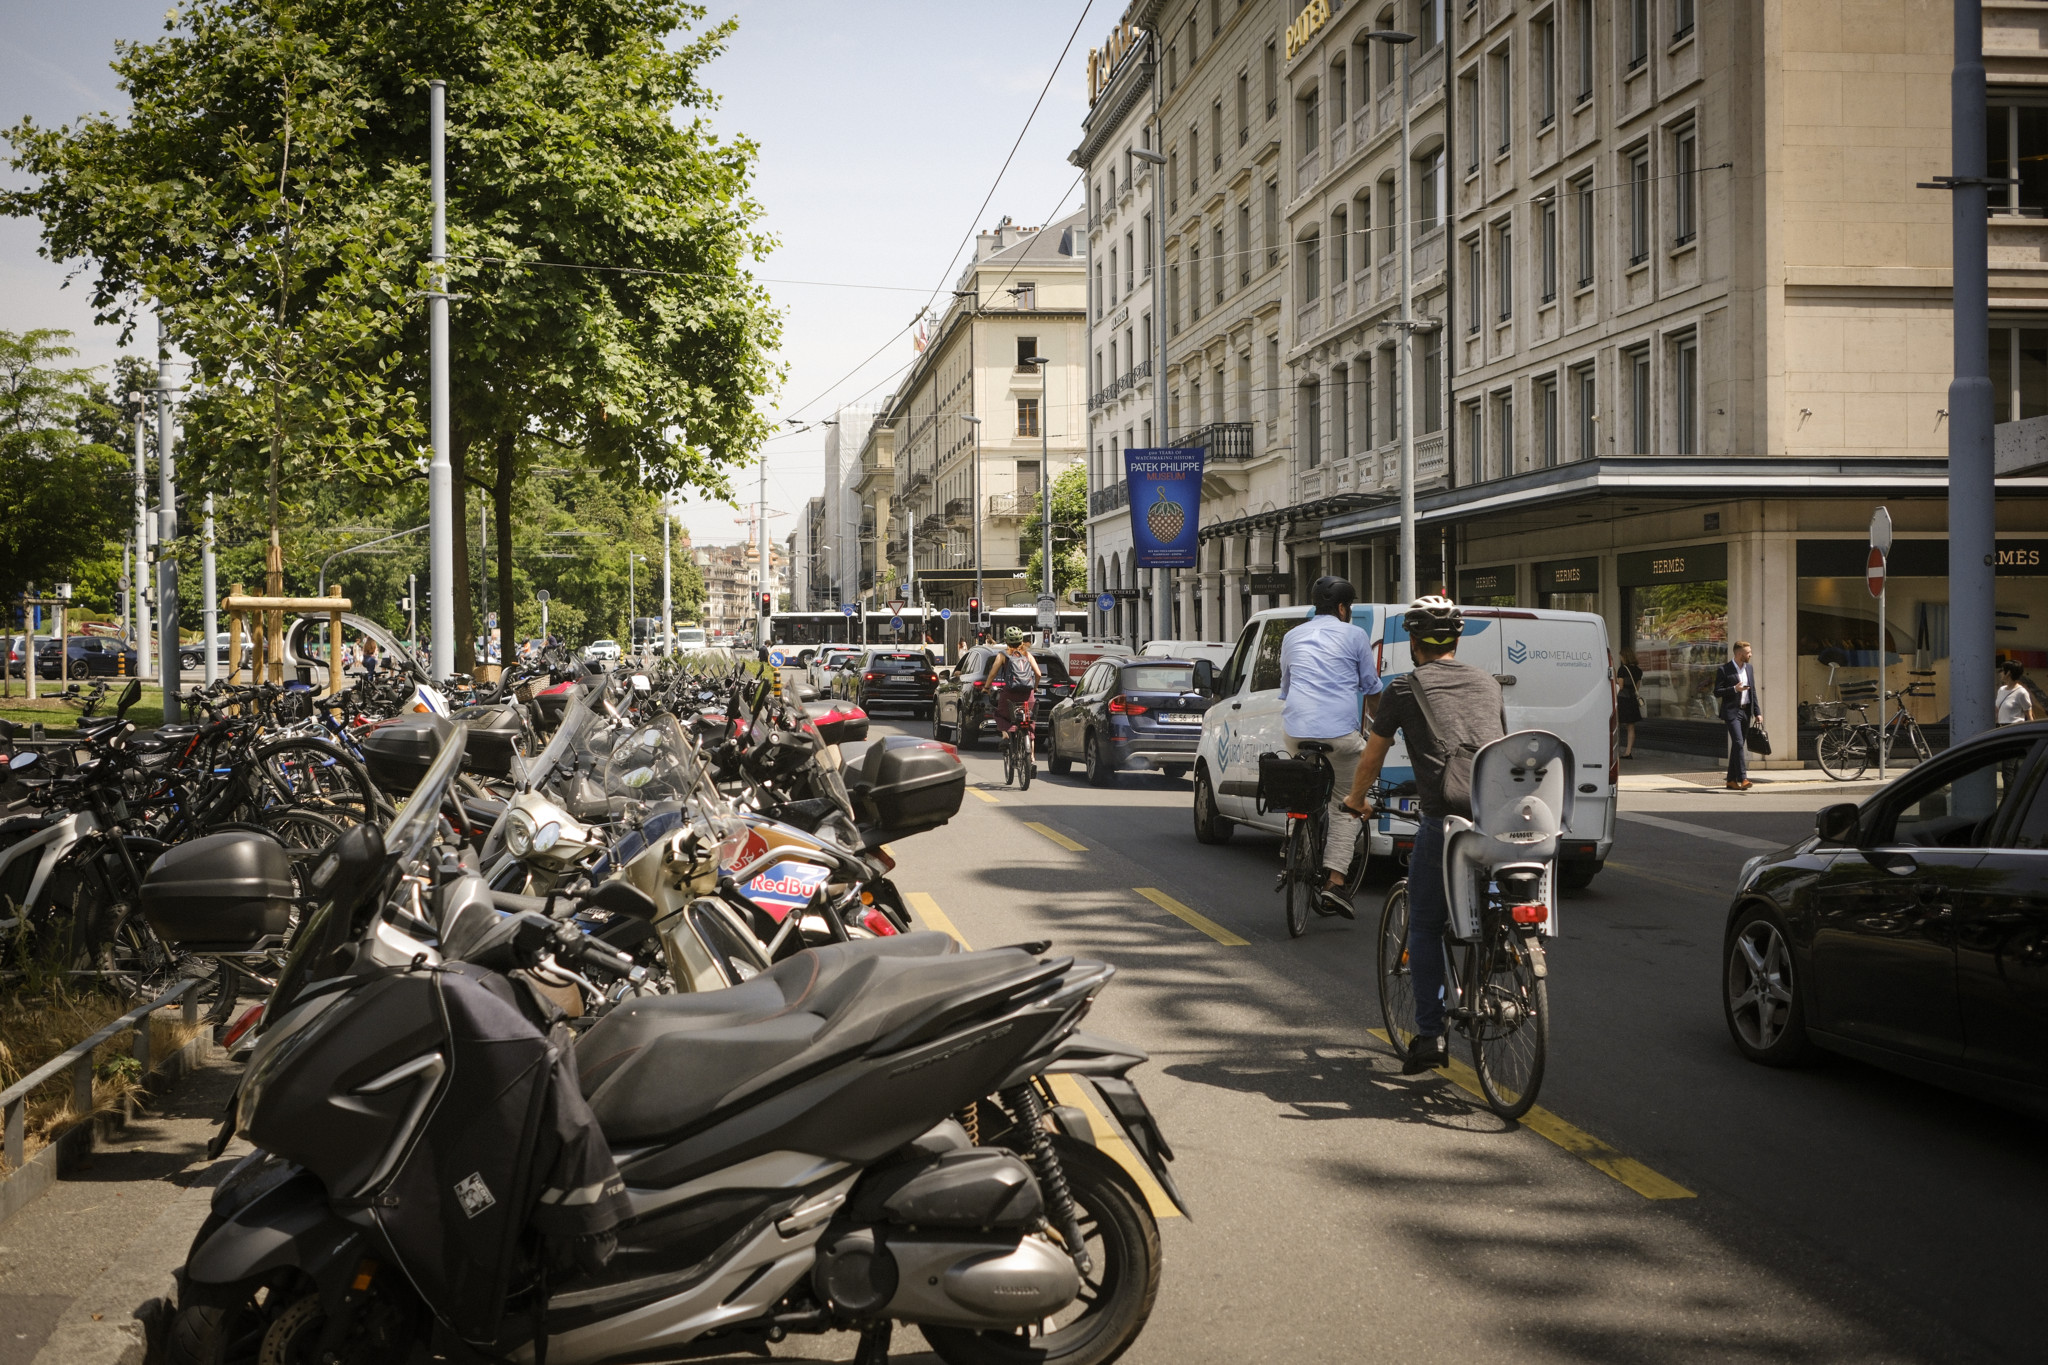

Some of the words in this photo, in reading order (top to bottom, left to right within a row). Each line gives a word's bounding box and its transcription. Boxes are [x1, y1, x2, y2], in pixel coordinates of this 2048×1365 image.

[1130, 462, 1159, 472] PATEK
[1160, 462, 1200, 472] PHILIPPE
[1147, 472, 1186, 480] MUSEUM
[1994, 549, 2040, 565] MÈS
[993, 1285, 1040, 1295] HONDA
